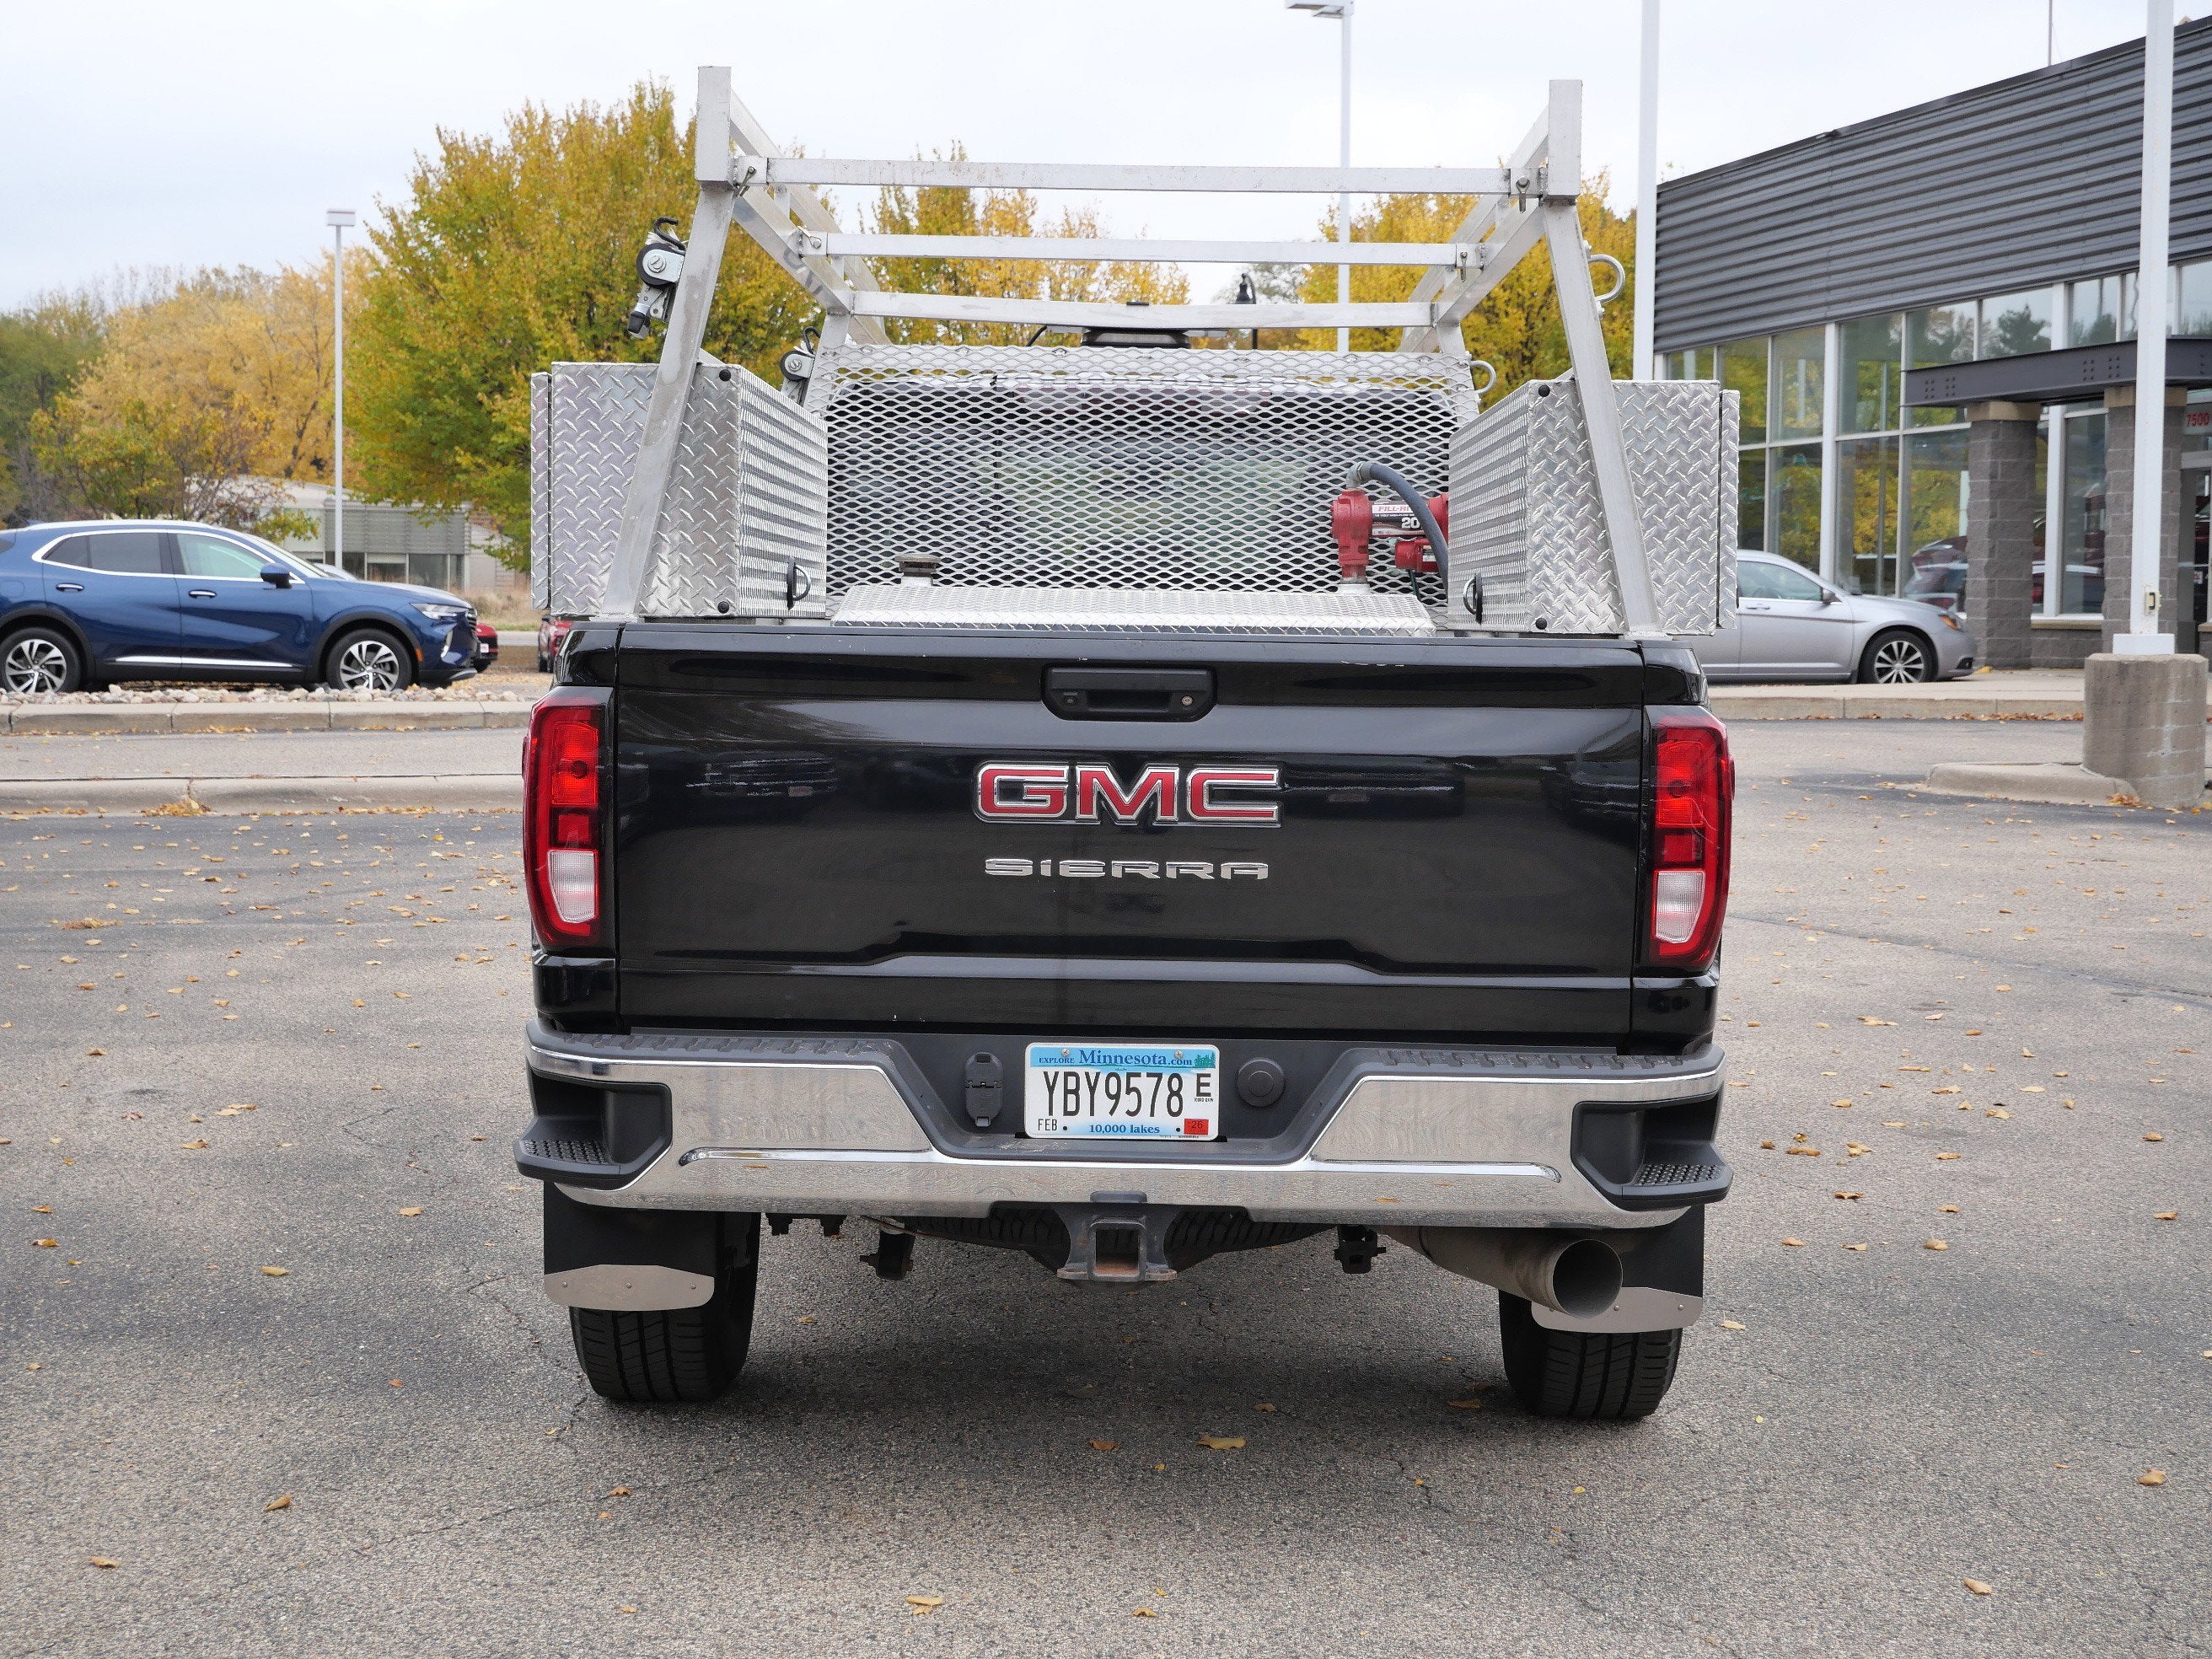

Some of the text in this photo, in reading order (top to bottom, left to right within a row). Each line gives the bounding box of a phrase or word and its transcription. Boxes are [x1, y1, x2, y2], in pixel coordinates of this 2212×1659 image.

[2187, 412, 2209, 427] 7500
[974, 761, 1280, 825] GMC
[985, 858, 1269, 880] SIERRA
[1079, 1049, 1192, 1066] Minnesota.com
[1196, 1072, 1212, 1098] E
[1043, 1071, 1184, 1118] YBY9578
[1038, 1119, 1058, 1131] FEB
[1089, 1125, 1160, 1134] 10,000 lakes
[1191, 1120, 1203, 1130] 26
